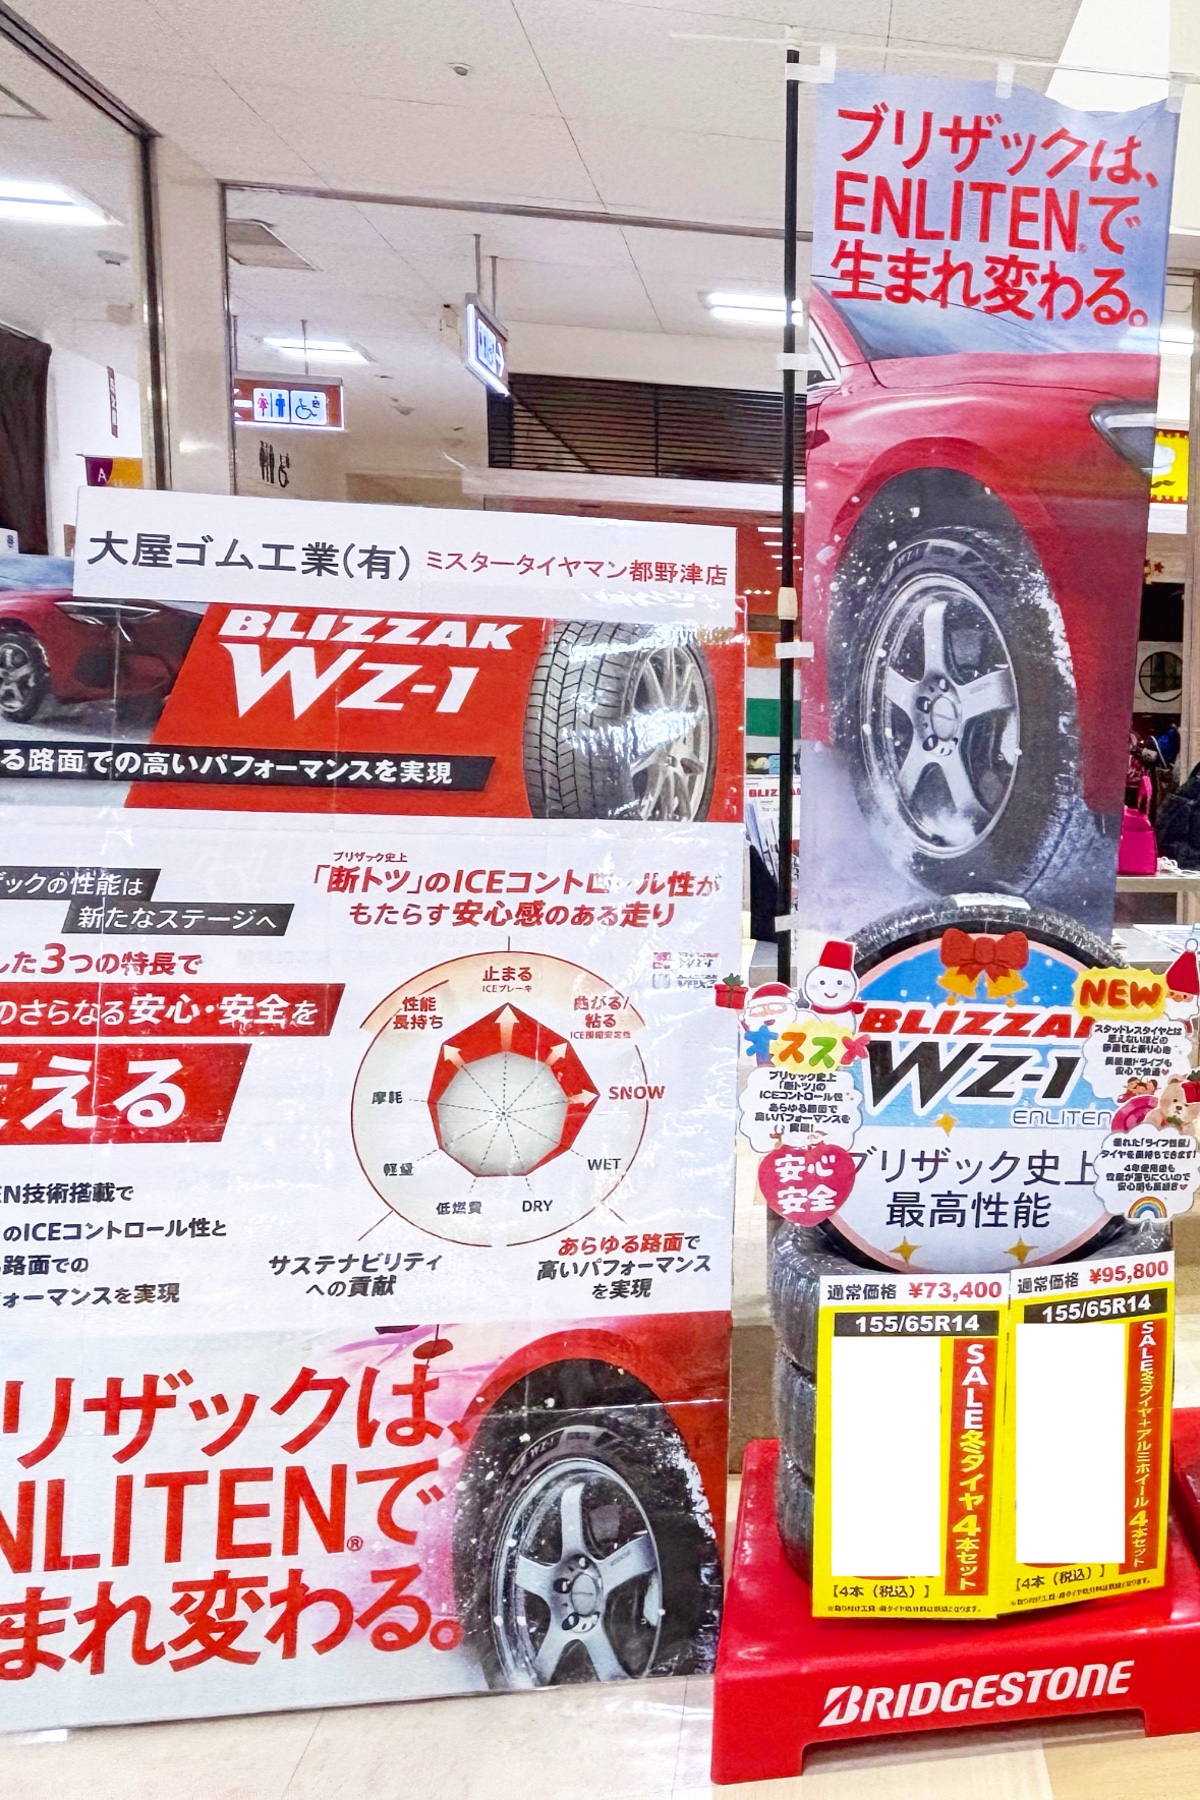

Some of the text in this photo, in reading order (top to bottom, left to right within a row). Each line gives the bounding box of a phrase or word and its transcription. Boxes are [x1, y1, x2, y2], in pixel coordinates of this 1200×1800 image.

[837, 102, 1158, 189] ブリザックは、
[830, 239, 1149, 329] 生まれ変わる。
[87, 530, 728, 587] 大屋ゴム工業(有) ミスタータイヤマン都野津店
[219, 609, 528, 649] BLIZZAK
[218, 641, 480, 721] WZ-1
[1, 748, 453, 785] る路面での高いパフォーマンスを実現
[333, 852, 407, 863] ブリザック史上
[0, 872, 143, 896] ックの性能は
[311, 866, 722, 898] 「断トツ」のICEコントロル性が
[78, 905, 278, 931] 新たなステージへ
[349, 901, 674, 928] もたらす安心感のある走り
[482, 966, 533, 982] 止まる
[402, 996, 437, 1012] 性能
[1079, 978, 1162, 1008] NEW
[393, 1014, 443, 1030] 長持ち
[585, 1013, 616, 1028] 粘る
[745, 1025, 870, 1070] オススメ
[867, 1040, 1081, 1109] WZ-1
[609, 1086, 666, 1099] SNOW
[587, 1158, 621, 1171] WET
[773, 1154, 838, 1183] 安心
[0, 1182, 134, 1204] N技術搭載で
[522, 1200, 553, 1212] DRY
[777, 1184, 838, 1215] 安全
[436, 1201, 483, 1215] 低燃費
[886, 1190, 1052, 1228] 最高性能
[3, 1218, 227, 1242] のICEコントロール性と
[559, 1232, 700, 1256] あらゆる路面で
[0, 1255, 89, 1276] 路面での
[269, 1252, 443, 1276] サステナビリティ
[537, 1255, 711, 1281] 高いパフォーマンス
[306, 1275, 397, 1298] への貢献
[592, 1279, 652, 1300] を実現
[1017, 1261, 1169, 1295] 通常価格 ¥95,800
[0, 1283, 180, 1309] ォーマンスを実現
[827, 1281, 1002, 1302] 通常価格 ¥73,400
[1042, 1295, 1152, 1323] 155/65R14
[855, 1314, 980, 1333] 155/65R14
[818, 1660, 1135, 1727] BRIDGESTONE
